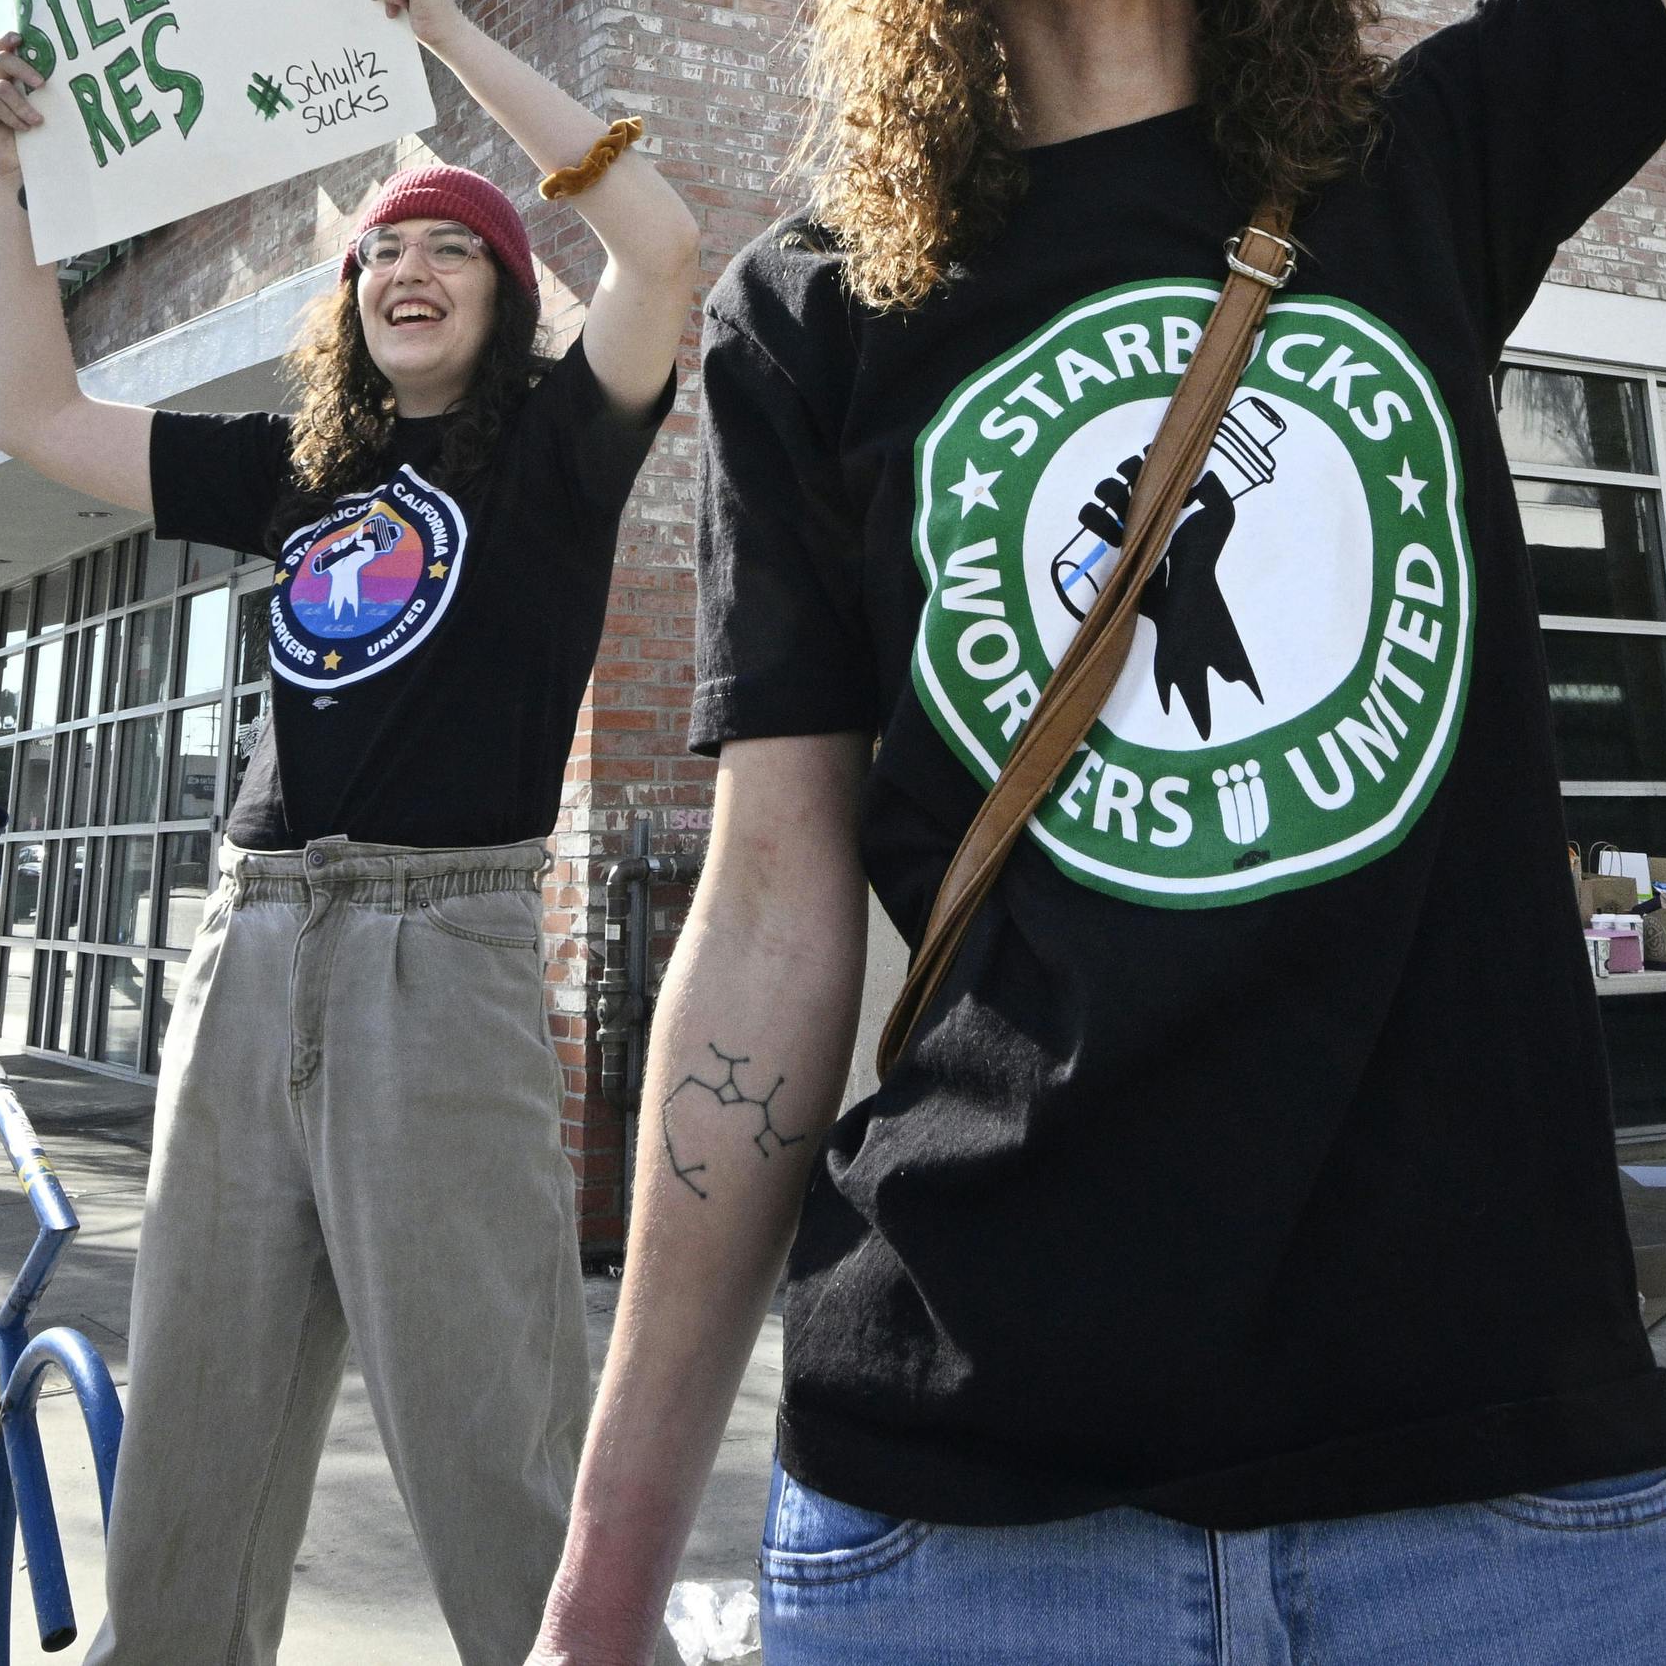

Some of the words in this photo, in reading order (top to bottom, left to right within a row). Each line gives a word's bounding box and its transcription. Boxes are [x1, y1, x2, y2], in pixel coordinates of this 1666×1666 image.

[68, 12, 204, 168] RES
[979, 316, 1412, 457] STARBCKS
[392, 482, 449, 558] CALIFORNIA
[269, 595, 317, 666] WORKERS
[367, 599, 426, 657] UNITED
[941, 537, 1193, 847] WORERS
[1285, 542, 1443, 810] UNITED
